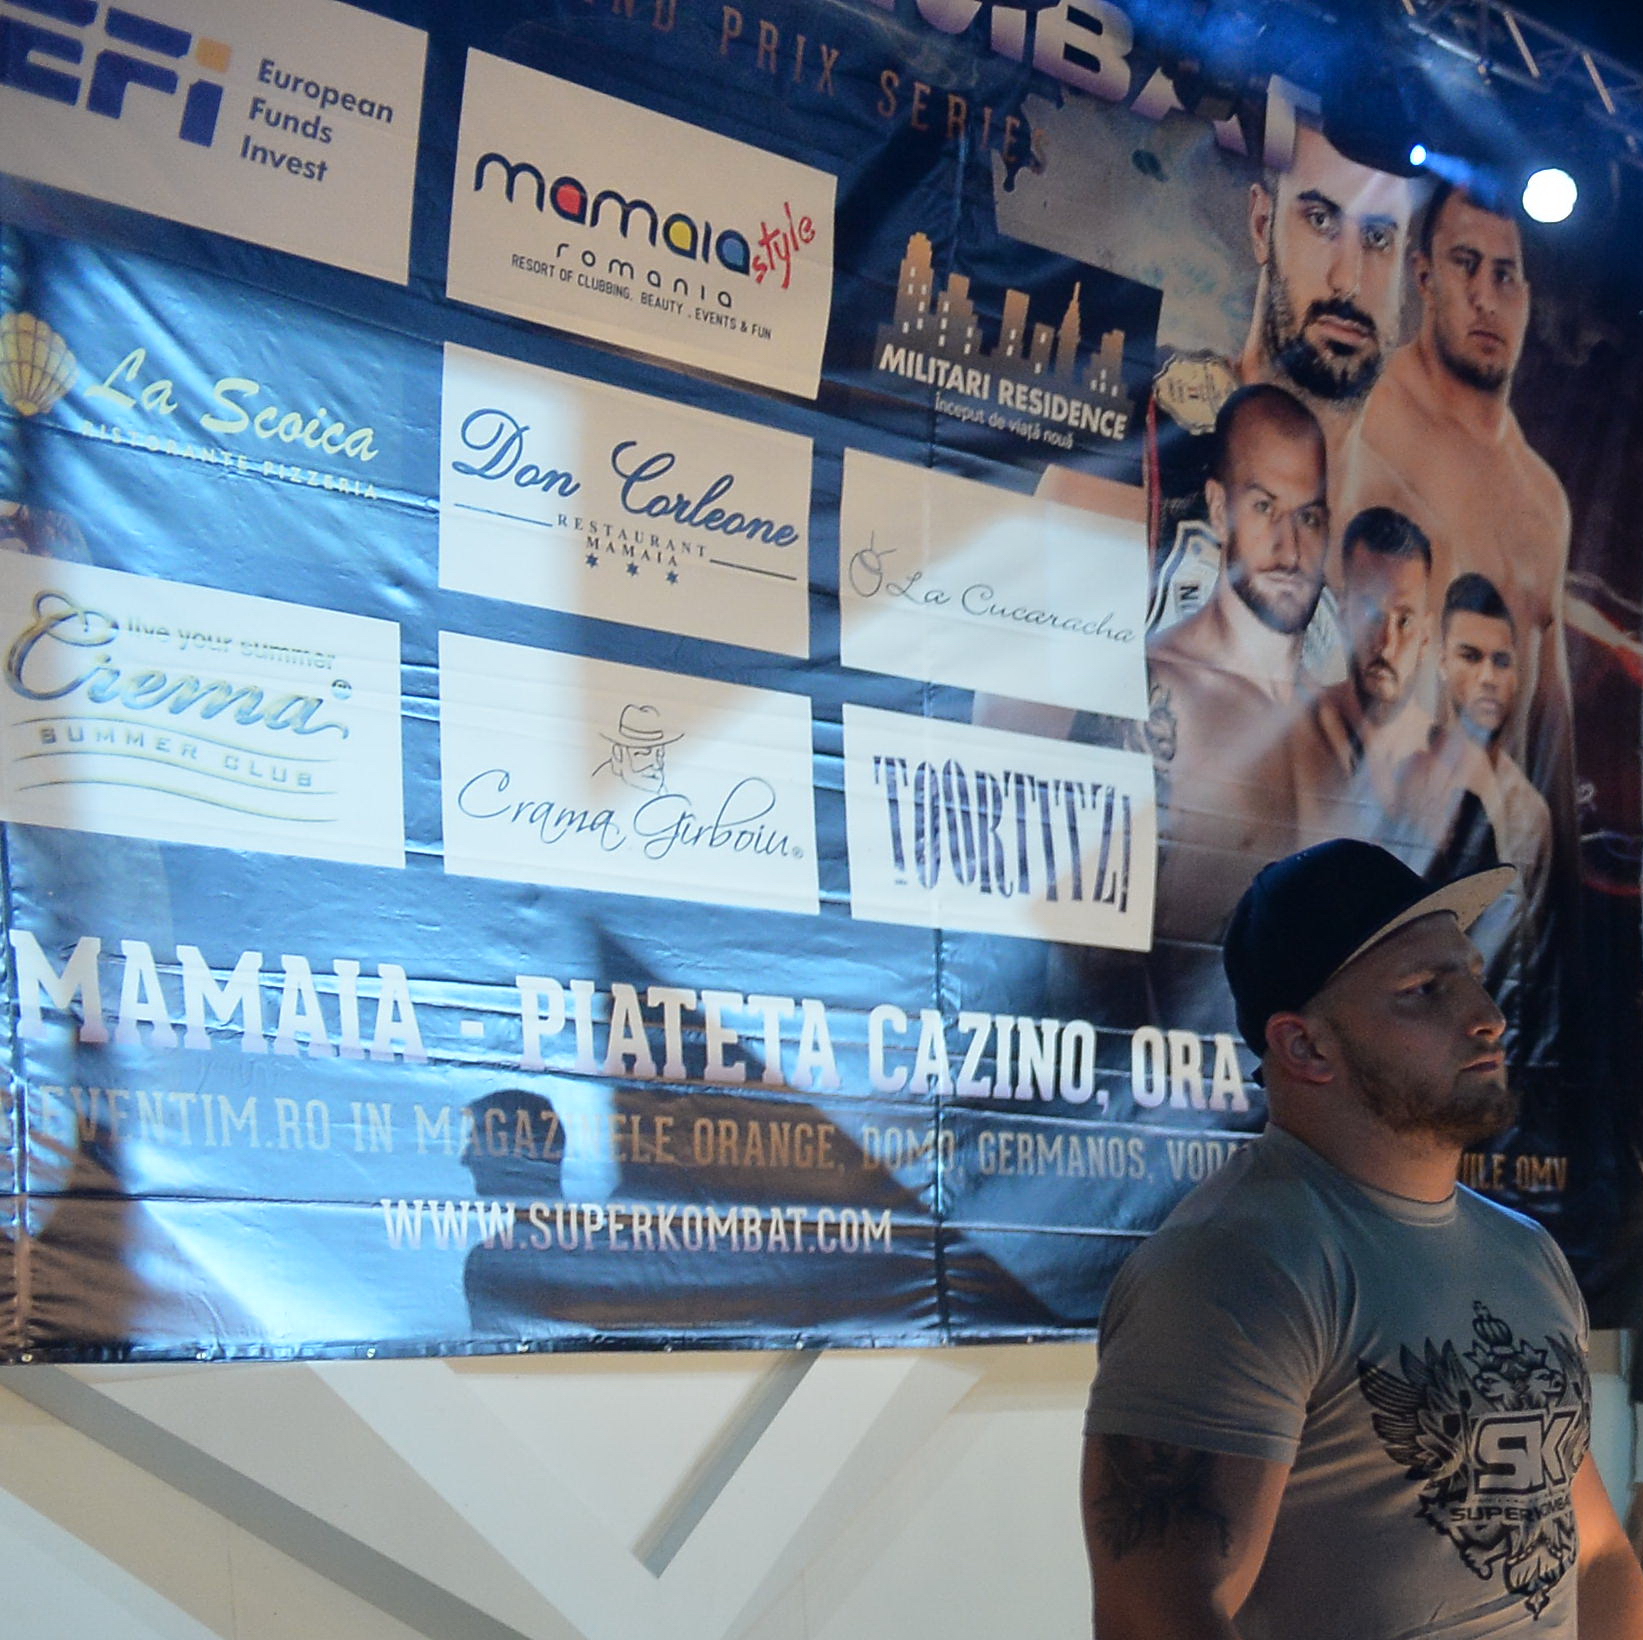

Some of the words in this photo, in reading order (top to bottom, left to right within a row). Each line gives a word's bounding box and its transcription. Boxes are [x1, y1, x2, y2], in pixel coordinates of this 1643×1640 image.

[257, 58, 394, 124] European
[719, 5, 840, 97] PRIX
[240, 134, 329, 182] Invest
[249, 96, 334, 144] Funds
[877, 69, 1048, 175] SERIES
[474, 152, 750, 276] mamaia
[752, 202, 816, 290] style
[511, 253, 555, 278] RESORT
[558, 268, 574, 283] OF
[640, 292, 683, 315] BEAUTY
[694, 307, 737, 331] EVENTS
[739, 320, 749, 332] &
[751, 321, 772, 340] FUN
[556, 243, 733, 308] romania
[83, 347, 178, 415] La
[200, 377, 379, 462] Scoica
[878, 343, 991, 400] MILITARI
[997, 378, 1129, 440] RESIDENCE
[988, 413, 1006, 431] de
[81, 420, 249, 471] RISTORANTE
[263, 459, 379, 501] PIZZERIA
[452, 408, 581, 498] Don
[610, 440, 799, 548] Corleone
[557, 513, 708, 558] RESTAURANT
[585, 535, 679, 567] MAMAIA
[128, 613, 171, 636] live
[177, 626, 233, 652] your
[885, 570, 950, 606] La
[961, 583, 1136, 644] Cucaracha
[4, 589, 349, 740] Crema
[40, 726, 199, 761] SUMMER
[223, 753, 314, 788] CLUB
[458, 768, 627, 853] Crama
[9, 929, 429, 1064] MAMAIA
[516, 975, 842, 1089] PIATETA
[867, 1004, 1111, 1114] CAZINO,
[40, 1085, 331, 1151] EVENTIM.RO
[353, 1100, 394, 1154] IN
[414, 1104, 676, 1165] MAGAZINELE
[692, 1117, 846, 1174] ORANGE,
[978, 1130, 1154, 1183] GERMANOS,
[1516, 1155, 1568, 1192] OMV
[380, 1197, 892, 1256] WWW.SUPERKOMBAT.COM
